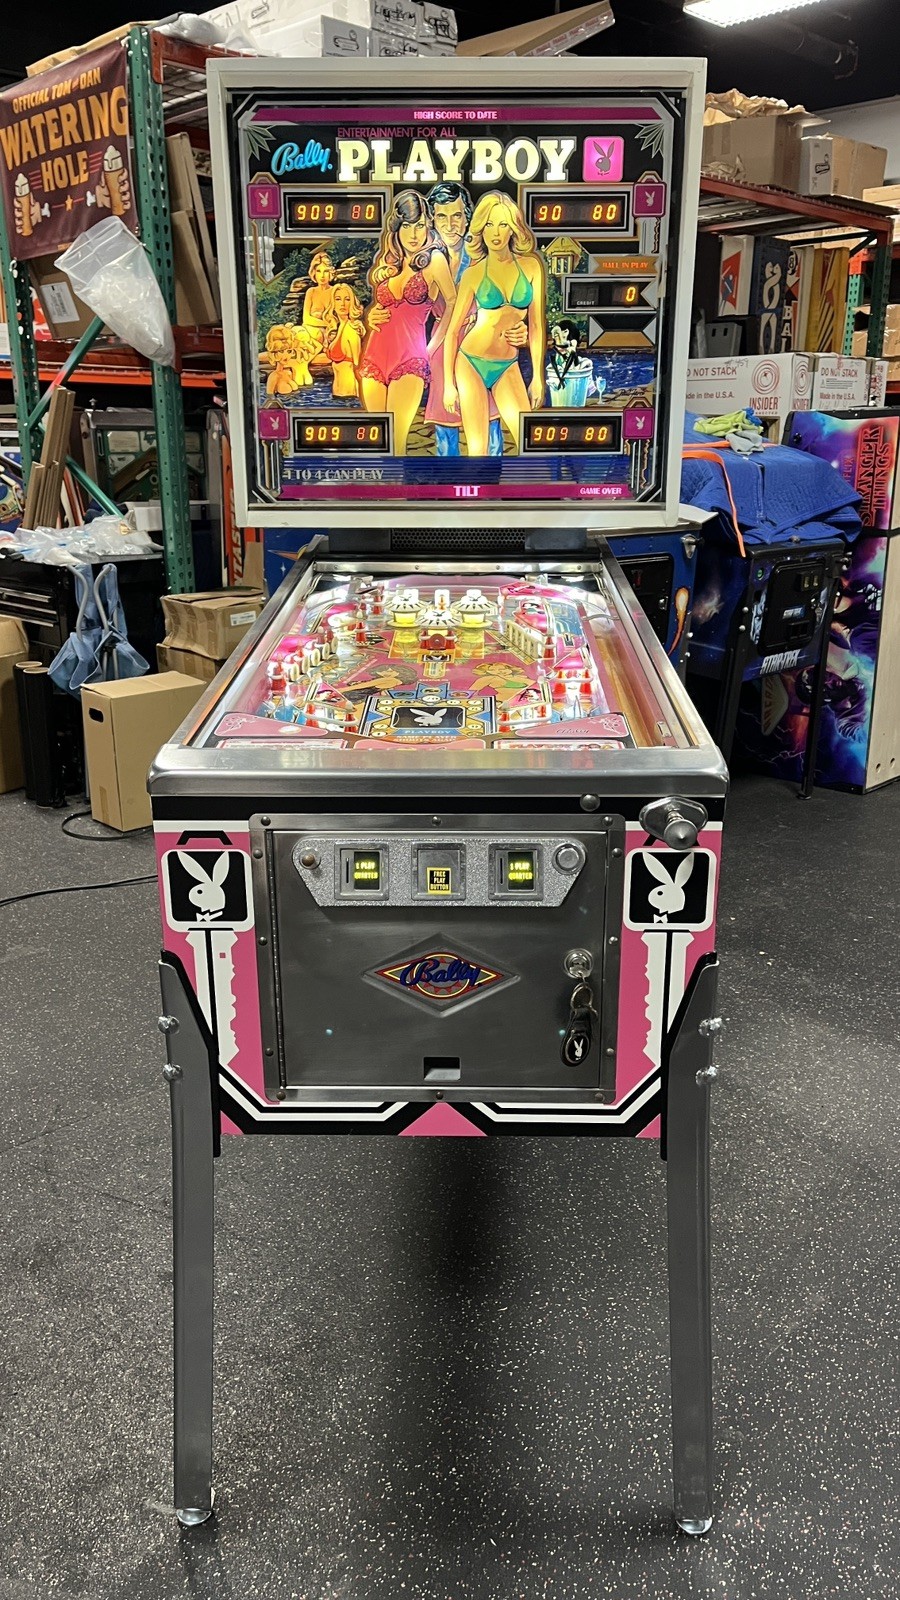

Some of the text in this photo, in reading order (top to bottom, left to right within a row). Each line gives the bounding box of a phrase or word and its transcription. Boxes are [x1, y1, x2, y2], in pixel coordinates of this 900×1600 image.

[13, 87, 50, 114] OFFICIAL
[51, 78, 72, 100] TOM
[80, 67, 101, 87] DAN
[414, 111, 498, 120] HIGH SCORE TO DATE
[0, 85, 129, 171] WATERING
[337, 127, 457, 138] ENTERTAINMENT FOR ALL
[271, 139, 331, 176] Bally
[337, 139, 576, 183] PLAYBOY
[41, 151, 90, 193] HOLE
[693, 368, 709, 377] NOT
[711, 367, 737, 376] STACK
[821, 368, 829, 376] DO
[842, 369, 858, 378] STACK
[696, 391, 703, 399] in
[704, 391, 714, 399] the
[749, 397, 779, 411] INSIDER
[294, 469, 312, 480] TO
[314, 469, 323, 480] 4
[324, 469, 350, 480] CAN
[352, 469, 384, 480] PLAY
[857, 425, 884, 527] STRANGER
[873, 443, 892, 511] THINGS
[453, 485, 481, 497] TILT
[580, 487, 622, 495] GAME OVER
[760, 649, 801, 674] STAR TREK
[354, 872, 378, 880] QUARTER
[433, 870, 446, 878] FREE
[508, 872, 533, 881] QUARTER
[400, 958, 482, 988] Bally
